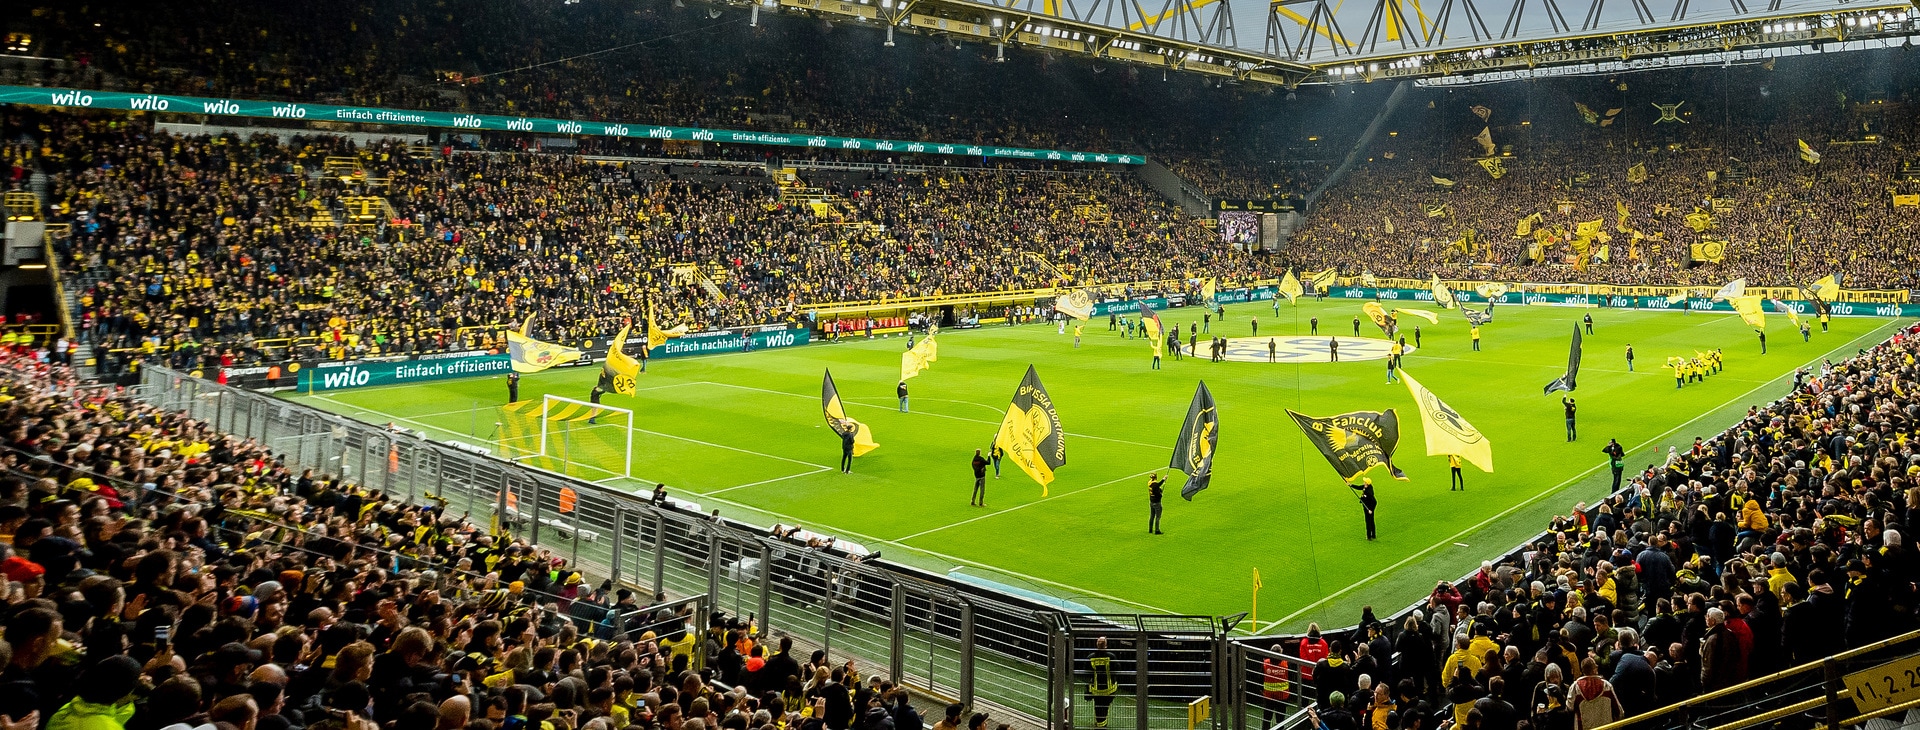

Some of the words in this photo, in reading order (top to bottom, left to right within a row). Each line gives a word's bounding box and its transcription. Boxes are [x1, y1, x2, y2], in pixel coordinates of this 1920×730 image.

[52, 90, 93, 107] wilo
[130, 95, 169, 111] wilo
[203, 100, 240, 115] wilo
[272, 104, 306, 119] wilo
[336, 109, 373, 120] Einfach
[376, 111, 426, 123] effizienter.
[453, 115, 482, 128] wilo
[506, 118, 533, 131] wilo
[557, 121, 582, 133] wilo
[604, 124, 629, 136] wilo
[650, 127, 673, 139] wilo
[692, 129, 714, 141] wilo
[732, 133, 757, 142] Einfach
[807, 136, 827, 147] wilo
[842, 138, 861, 149] wilo
[875, 140, 893, 151] wilo
[907, 142, 925, 153] wilo
[937, 144, 954, 154] wilo
[967, 145, 983, 156] wilo
[1047, 151, 1061, 160] wilo
[1095, 153, 1108, 163] wilo
[1118, 155, 1131, 164] wilo
[1260, 288, 1273, 299] wilo
[1345, 288, 1364, 299] wilo
[1379, 289, 1398, 301] wilo
[1414, 290, 1434, 301] wilo
[1525, 294, 1547, 305] wilo
[1107, 302, 1130, 313] Einfach
[1565, 296, 1587, 307] wilo
[1647, 298, 1670, 310] wilo
[1690, 299, 1714, 310] wilo
[1876, 304, 1903, 317] wilo
[665, 340, 700, 354] Einfach
[766, 329, 795, 348] wilo
[395, 365, 443, 379] Einfach
[447, 359, 510, 375] effizienter.
[324, 366, 370, 388] wilo
[1332, 416, 1383, 438] Fanclub
